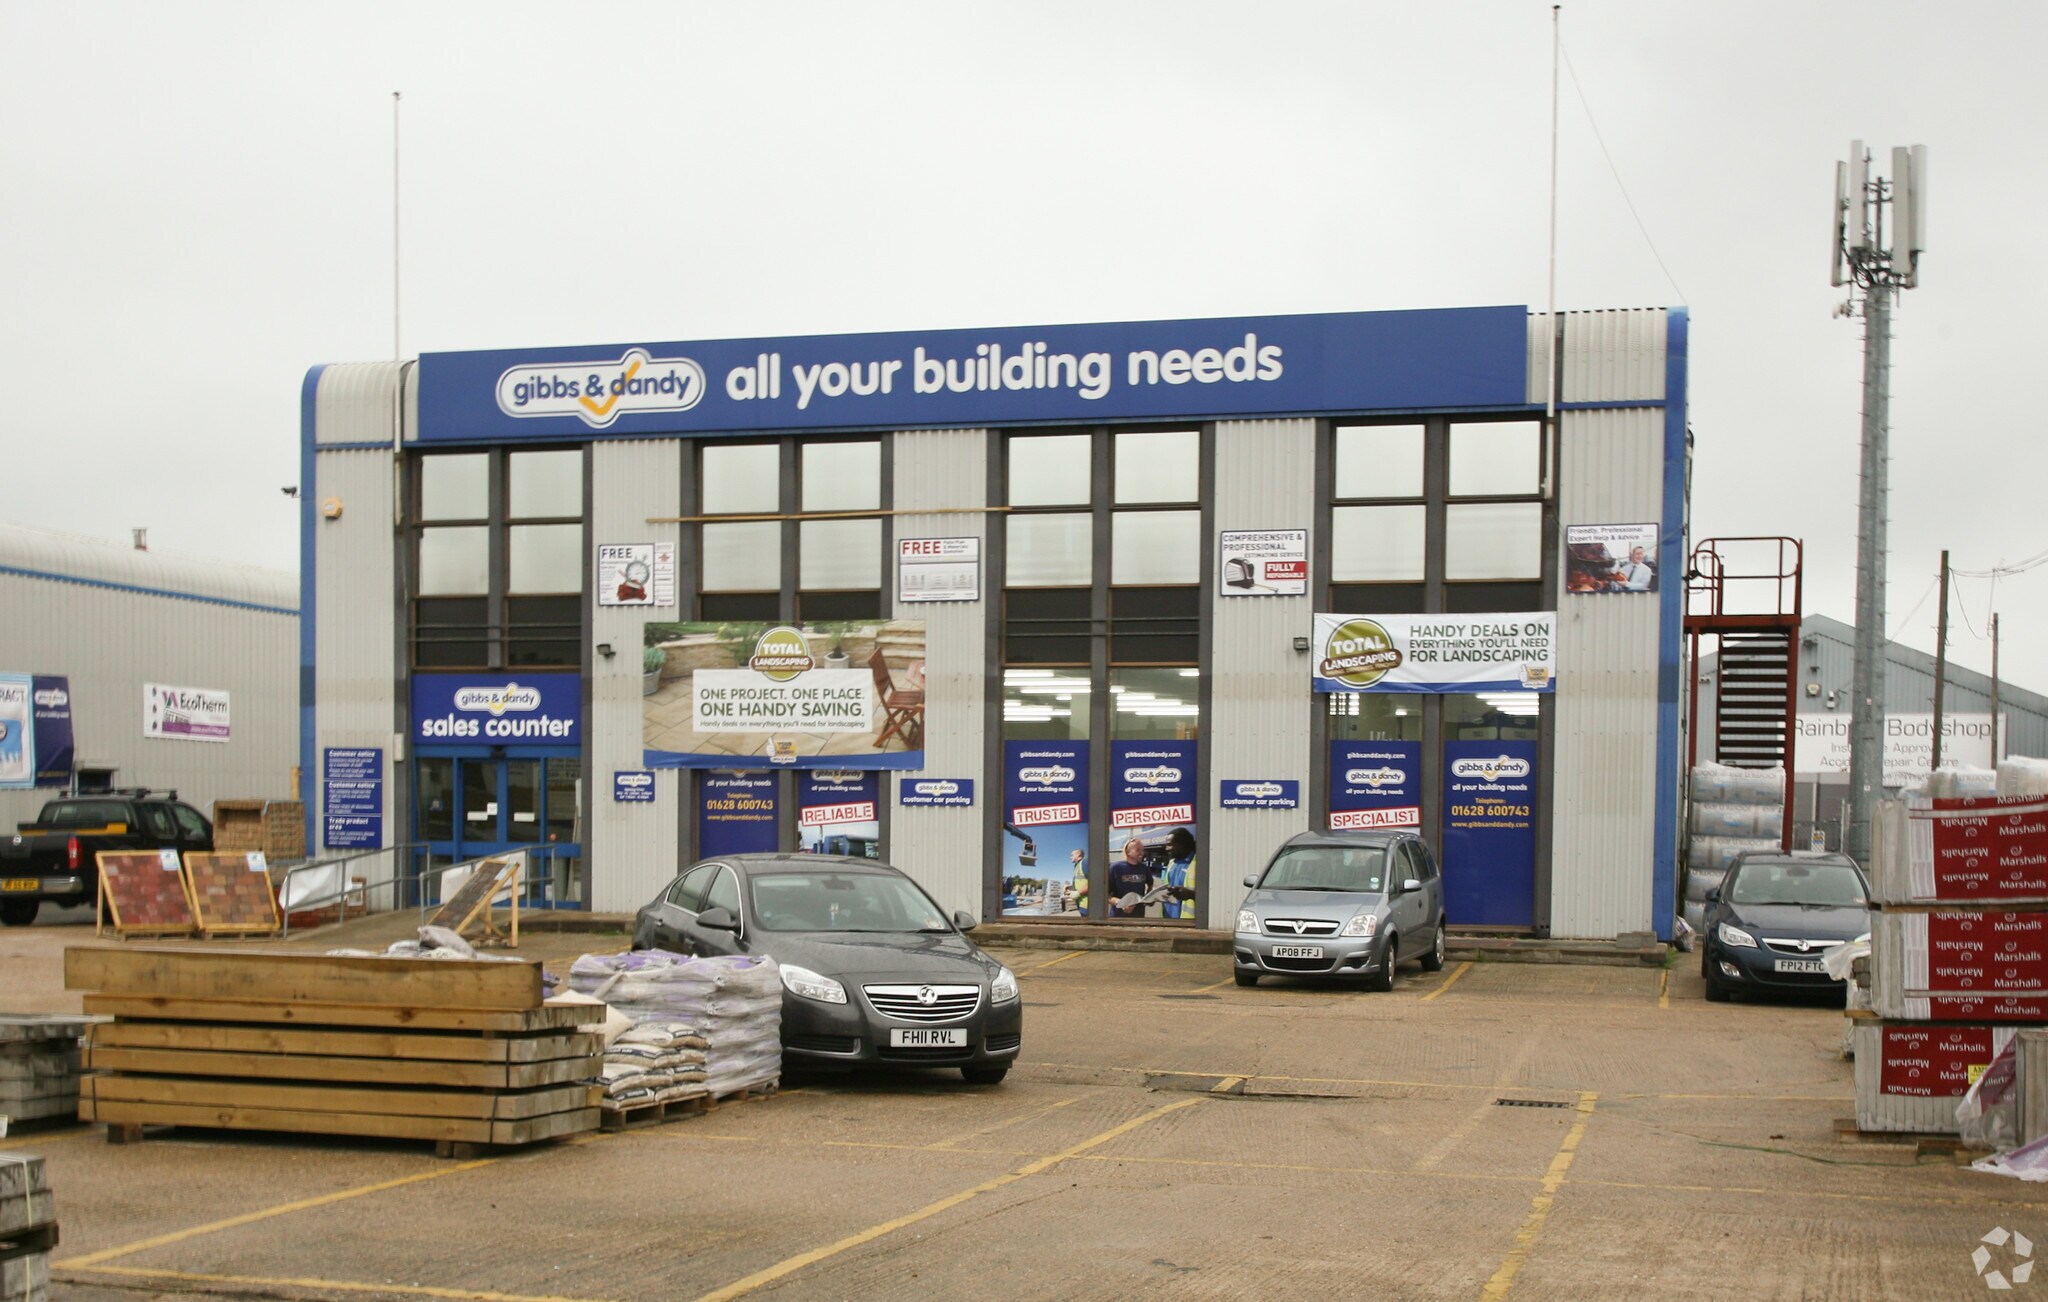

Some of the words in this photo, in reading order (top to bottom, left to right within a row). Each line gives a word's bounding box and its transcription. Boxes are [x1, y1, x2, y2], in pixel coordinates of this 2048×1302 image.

[726, 353, 780, 400] all
[792, 359, 902, 410] your
[914, 341, 1111, 400] building
[1128, 332, 1284, 386] needs
[514, 375, 580, 406] gibbs
[586, 374, 604, 398] &
[610, 369, 691, 400] dandy
[1223, 534, 1294, 542] COMPREHENSIVE
[902, 541, 941, 554] FREE
[602, 548, 633, 559] FREE
[1266, 563, 1296, 572] FULLY
[1410, 625, 1466, 637] HANDY
[1471, 624, 1518, 637] DEALS
[1524, 624, 1549, 636] ON
[1332, 636, 1386, 655] TOTAL
[1410, 639, 1475, 648] EVERYTHING
[1479, 639, 1516, 648] YOU'LL
[1521, 638, 1549, 647] NEED
[762, 643, 802, 655] TOTAL
[1410, 650, 1438, 662] FOR
[1443, 649, 1548, 662] LANDSCAPING
[755, 658, 809, 666] LANDSCAPING
[1325, 652, 1396, 670] LANDSCAPING
[700, 688, 726, 700] ONE
[730, 688, 787, 700] PROJECT.
[792, 688, 818, 700] ONE
[823, 688, 865, 700] PLACE.
[180, 693, 227, 712] EcoTherm
[462, 693, 489, 706] gibbs
[492, 694, 500, 703] &
[502, 693, 535, 705] dandy
[700, 702, 733, 716] ONE
[739, 702, 797, 716] HANDY
[802, 702, 865, 716] SAVING.
[422, 713, 479, 737] sales
[485, 714, 574, 737] counter
[1458, 763, 1483, 773] gibbs
[1494, 763, 1524, 772] dandy
[1351, 772, 1370, 780] gibbs
[1378, 772, 1401, 781] dandy
[946, 796, 970, 804] parking
[1269, 798, 1295, 806] parking
[1998, 794, 2044, 804] Marshalls
[707, 800, 735, 809] 01628
[737, 800, 773, 809] 600743
[805, 804, 872, 822] RELIABLE
[1017, 808, 1077, 823] TRUSTED
[1451, 806, 1484, 816] 01628
[1487, 806, 1529, 816] 600743
[1115, 808, 1190, 825] PERSONAL
[1333, 811, 1415, 827] SPECIALIST
[1941, 817, 1988, 827] Marshalls
[1999, 824, 2046, 836] Marshalls
[1941, 848, 1988, 858] Marshalls
[2000, 855, 2047, 866] Marshalls
[1942, 873, 1989, 882] Marshalls
[2000, 880, 2046, 889] Marshalls
[1936, 912, 1983, 921] Marshalls
[1994, 921, 2042, 931] Marshalls
[1936, 941, 1983, 951] Marshalls
[1276, 948, 1299, 957] AP08
[1301, 949, 1319, 957] FFJ
[1994, 952, 2041, 962] Marshalls
[1781, 961, 1803, 970] FP12
[1936, 968, 1983, 977] Marshalls
[1994, 979, 2041, 988] Marshalls
[1994, 1006, 2040, 1015] Marshalls
[902, 1031, 927, 1043] FH11
[931, 1031, 955, 1043] RVL
[1889, 1032, 1928, 1041] Marshalls
[1939, 1042, 1985, 1052] Marshalls
[1888, 1059, 1929, 1069] Marshalls
[1888, 1085, 1931, 1095] Marshalls
